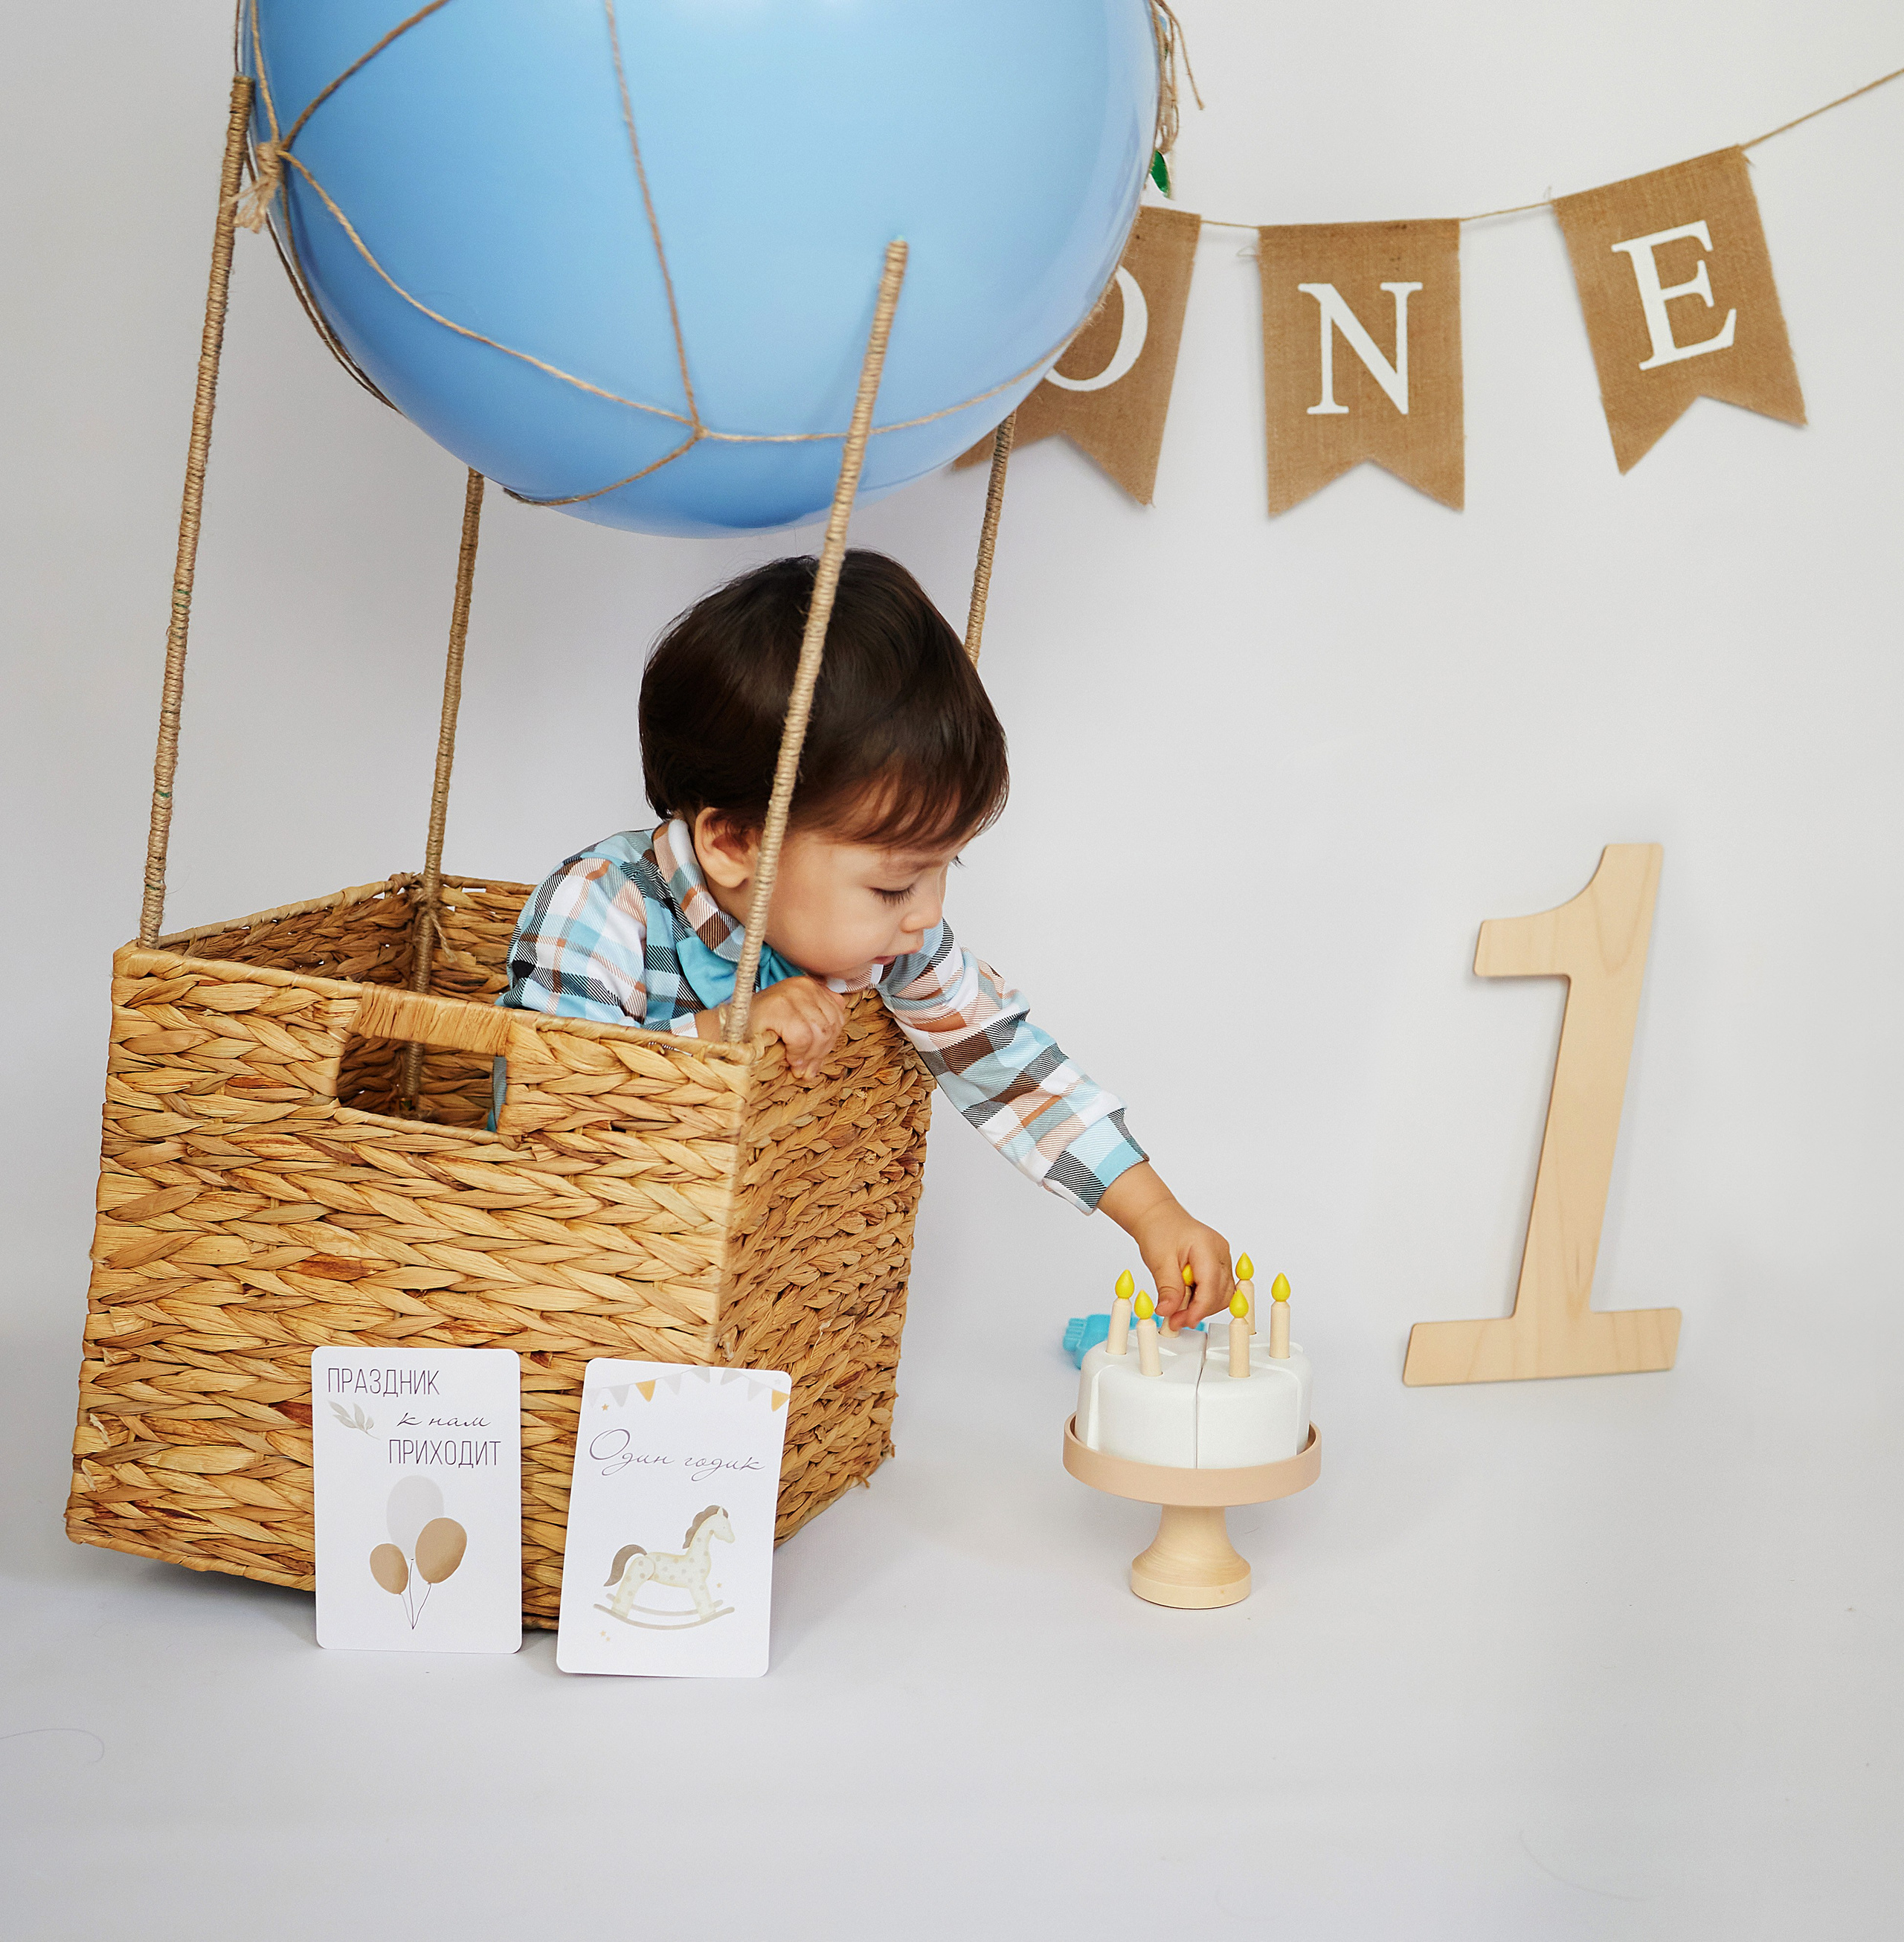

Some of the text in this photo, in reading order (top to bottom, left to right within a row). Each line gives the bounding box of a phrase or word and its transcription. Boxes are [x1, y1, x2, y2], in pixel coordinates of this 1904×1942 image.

[1402, 842, 1682, 1387] 1
[327, 1367, 440, 1398] ПРАЗДНИК
[396, 1412, 492, 1427] к нам
[388, 1438, 501, 1468] ПРИХОДИТ
[589, 1428, 765, 1482] Один годик
